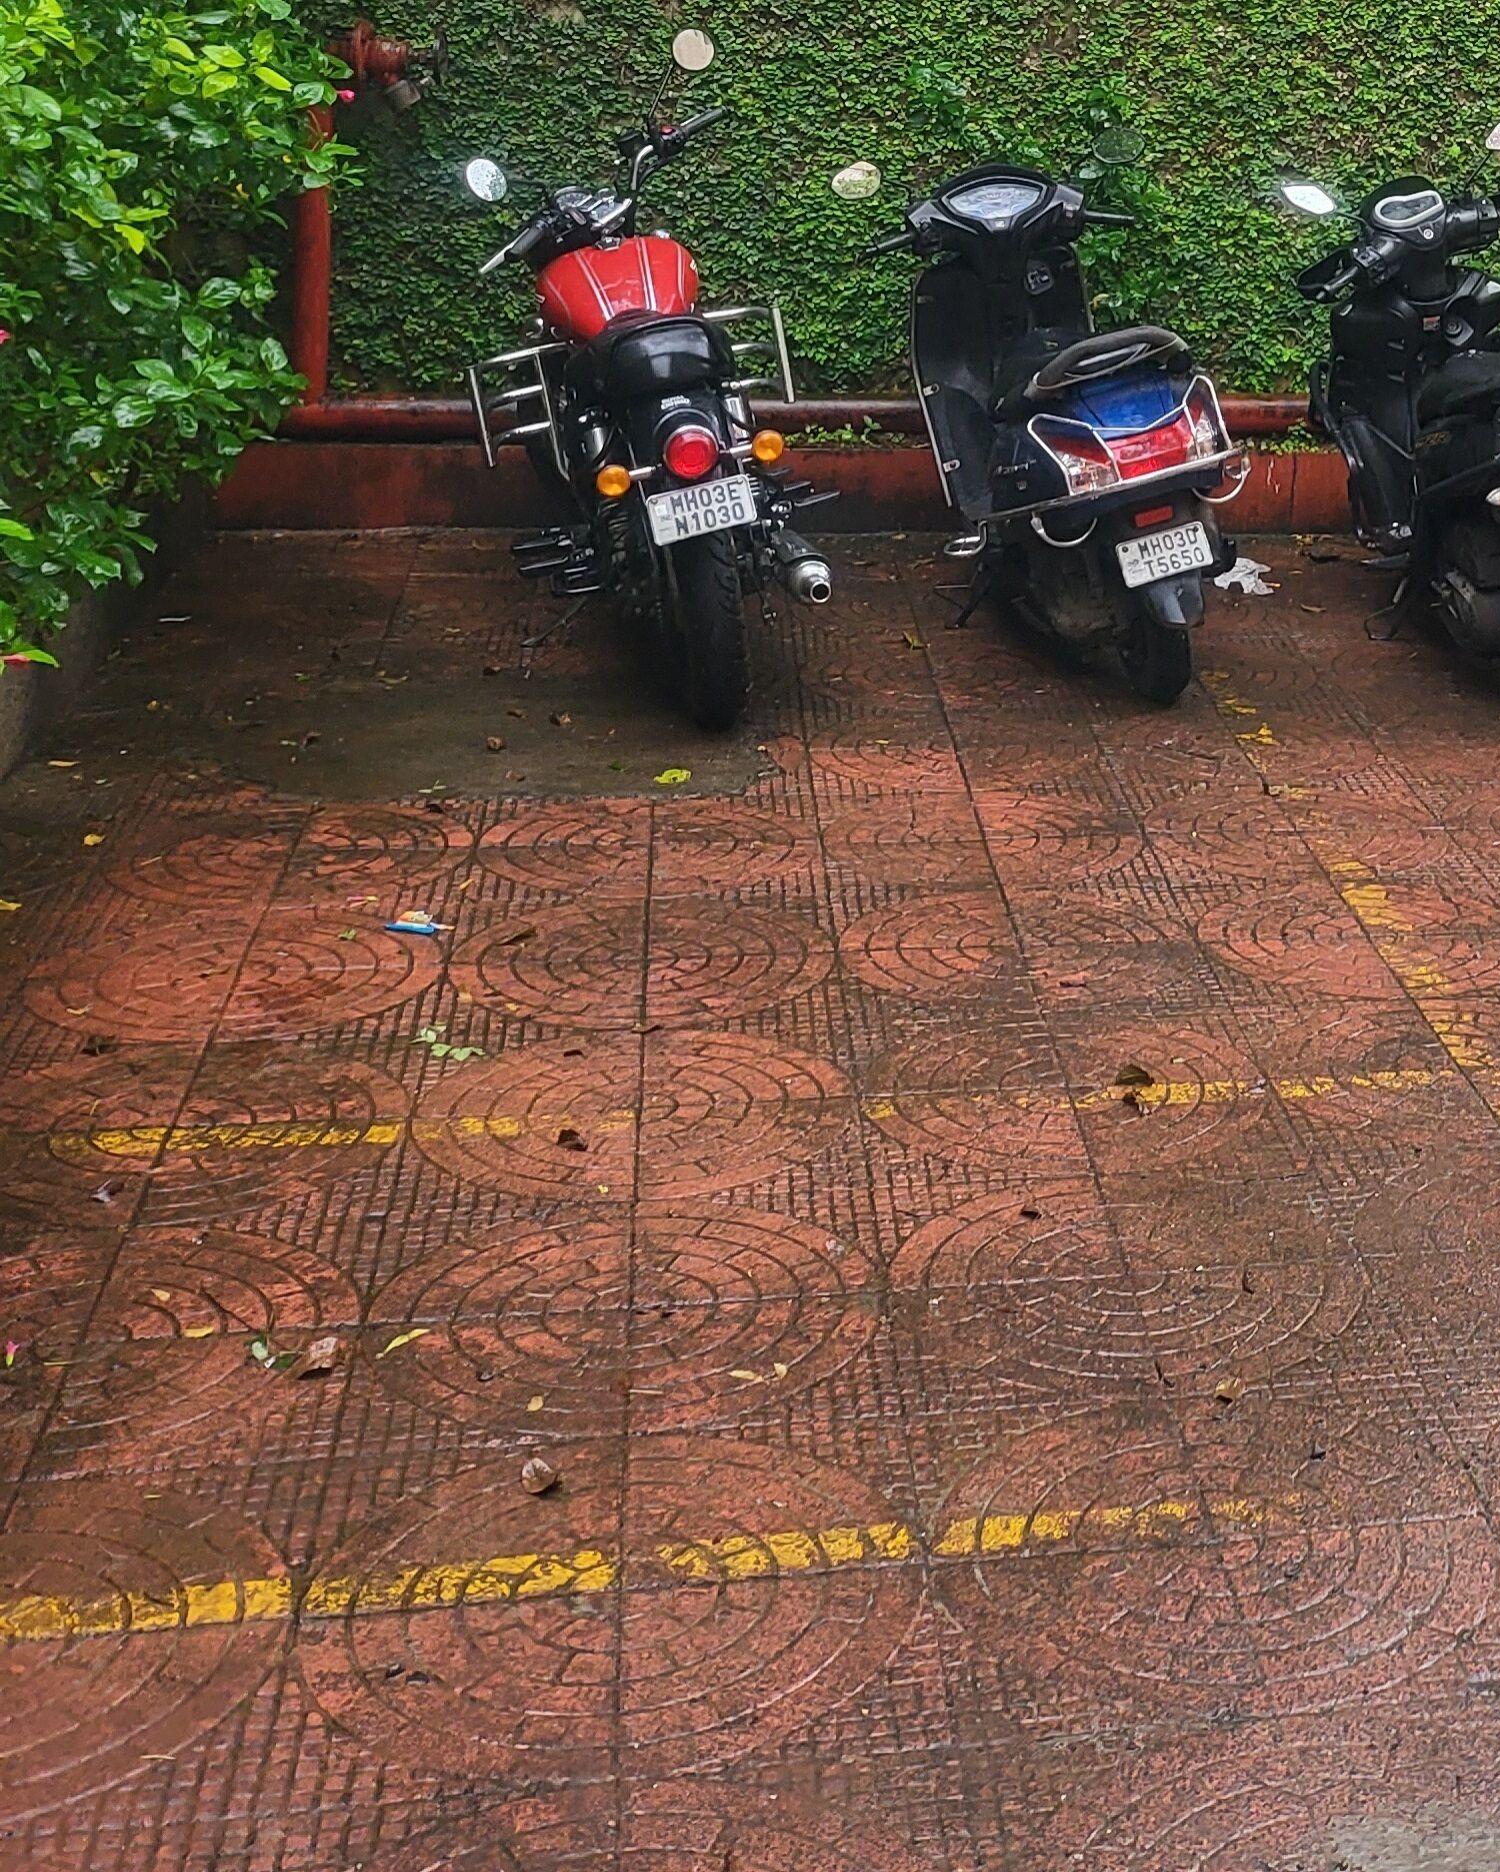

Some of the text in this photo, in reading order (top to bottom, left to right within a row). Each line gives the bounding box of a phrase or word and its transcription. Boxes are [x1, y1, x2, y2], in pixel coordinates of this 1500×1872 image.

[669, 481, 742, 516] MH03E
[674, 502, 746, 537] N1030
[1137, 528, 1200, 559] MH03D
[1143, 547, 1205, 578] T5650
